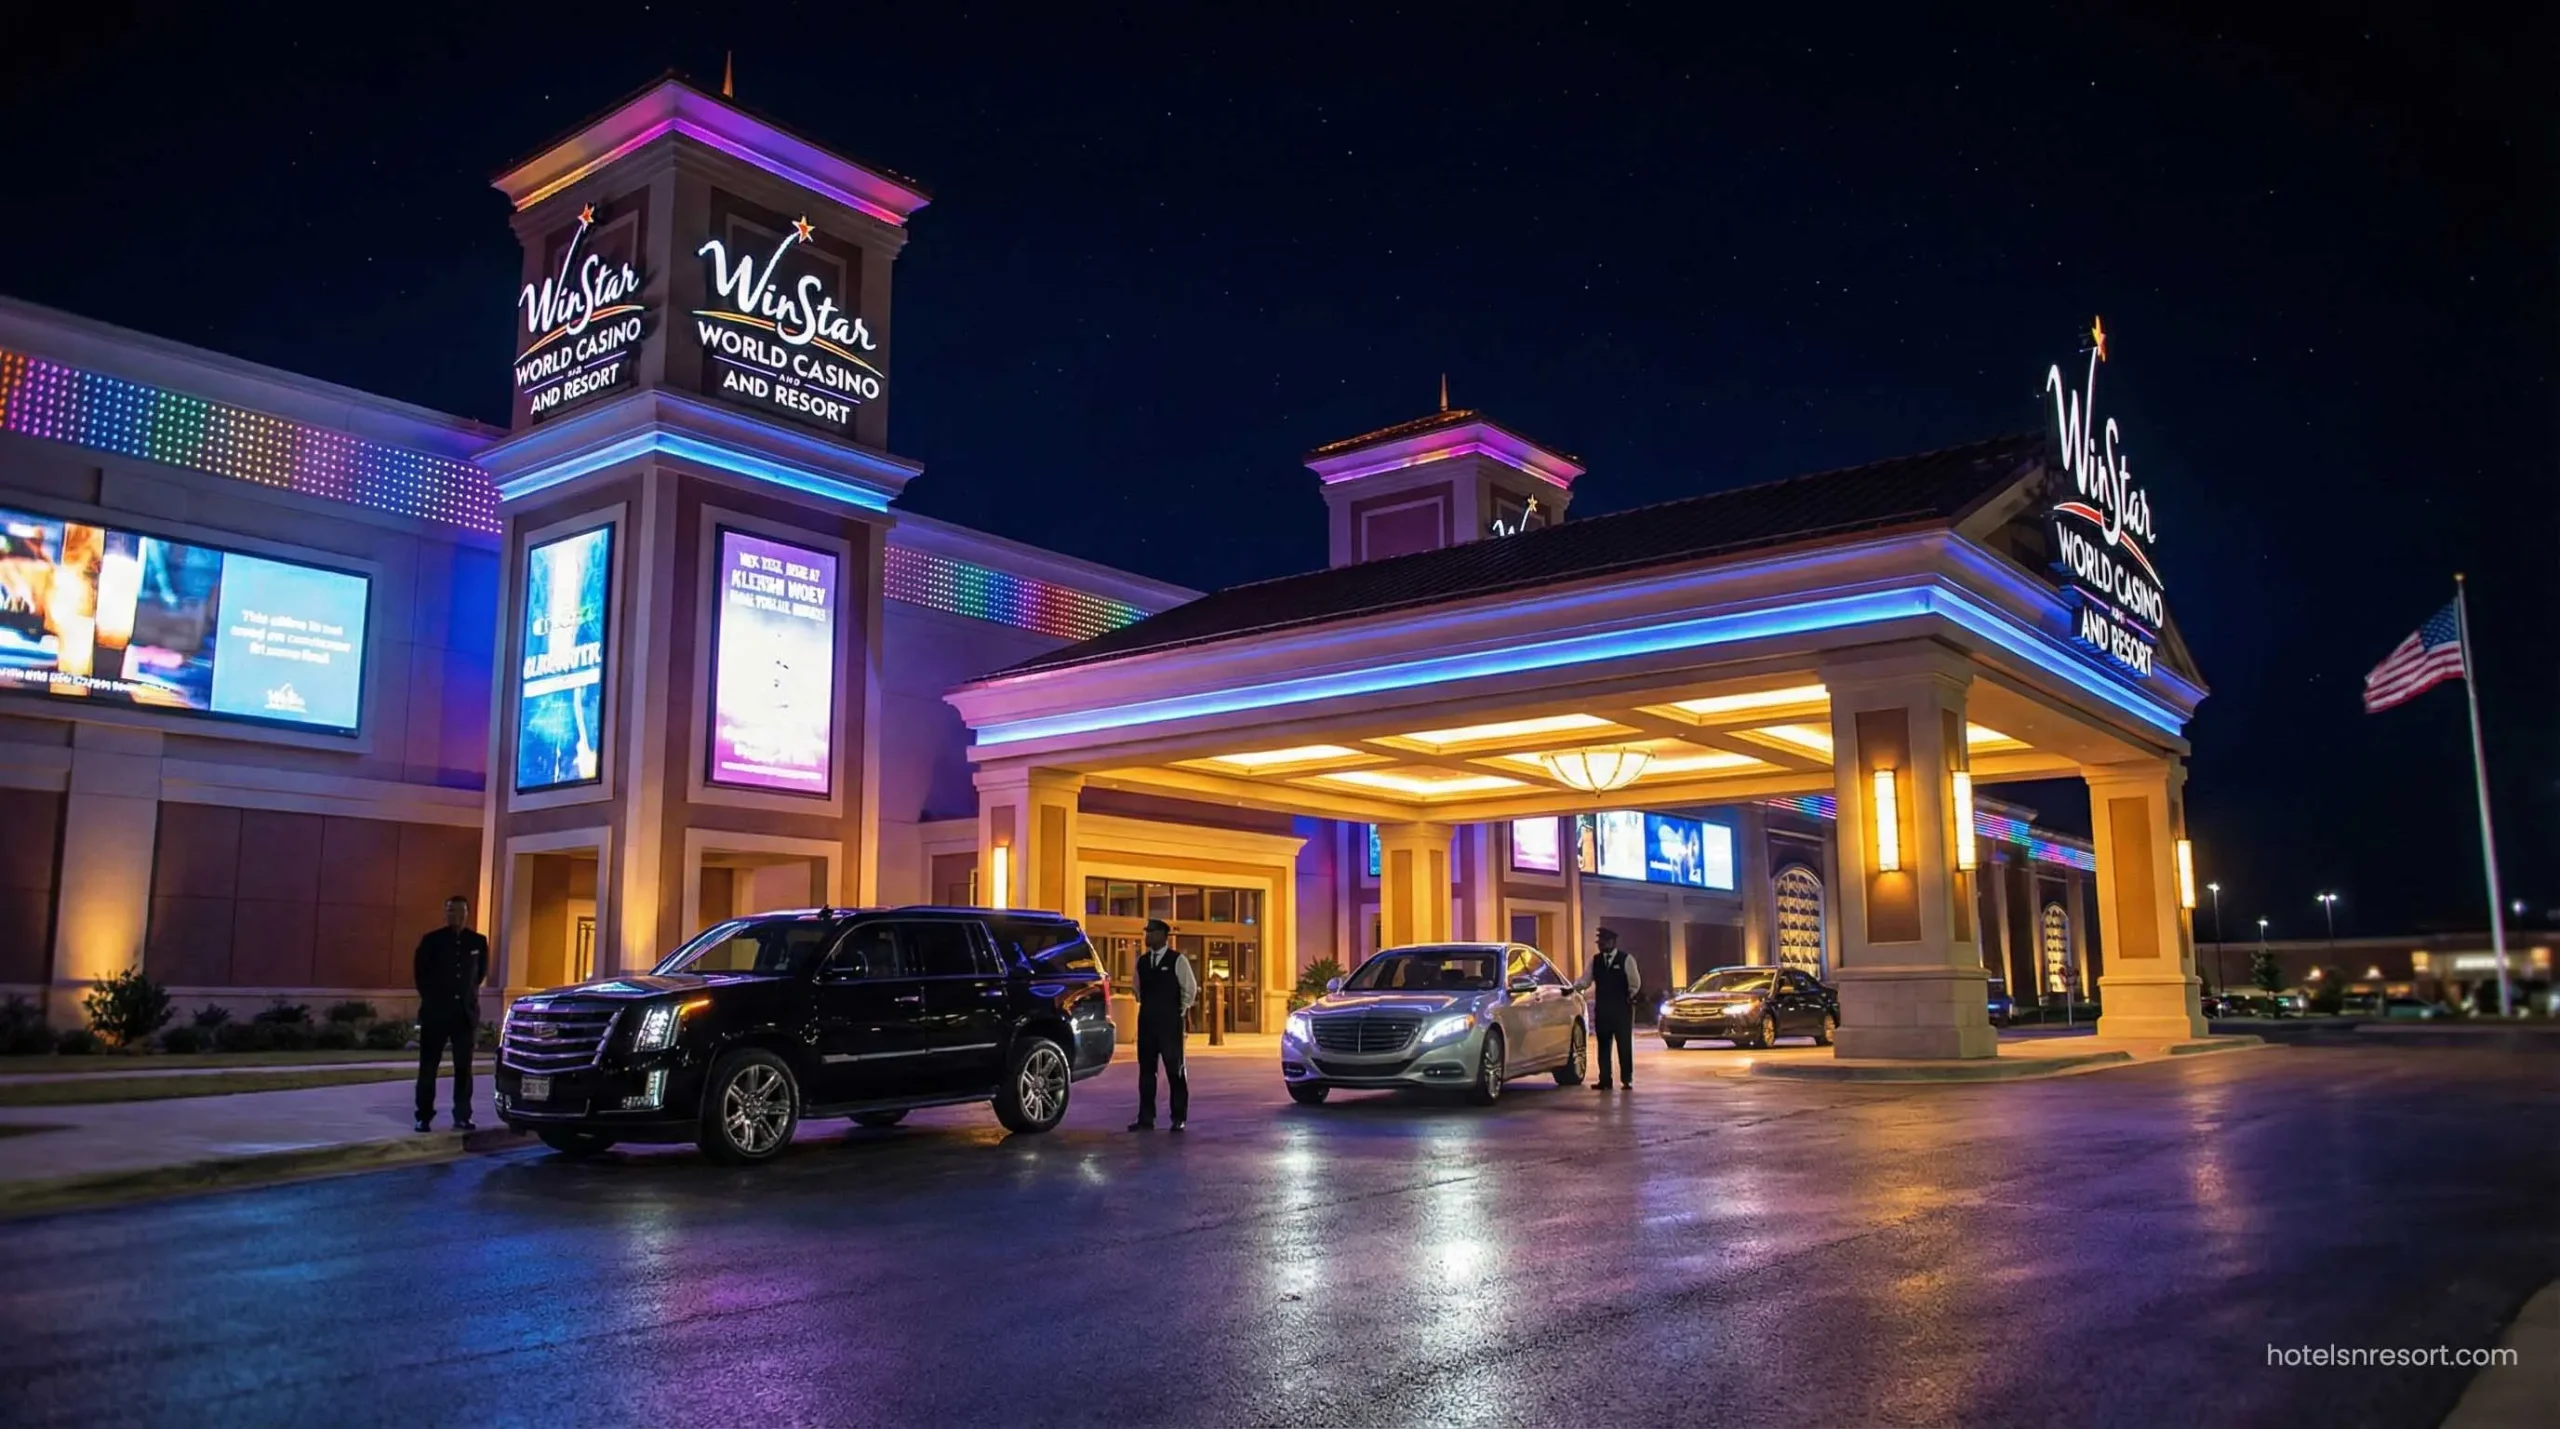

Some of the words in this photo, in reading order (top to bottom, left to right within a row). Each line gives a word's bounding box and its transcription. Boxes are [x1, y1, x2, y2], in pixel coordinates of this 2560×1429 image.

[518, 222, 640, 336] WinStar
[698, 229, 877, 352] WinStar
[515, 346, 573, 387] WORLD
[576, 317, 641, 362] CASINO
[530, 386, 560, 415] AND
[563, 362, 620, 401] RESORT
[697, 320, 788, 369] WORLD
[792, 354, 880, 400] CASINO
[778, 373, 801, 387] AND
[722, 369, 769, 398] AND
[775, 384, 850, 424] RESORT
[2046, 346, 2157, 547] WinStar
[2056, 521, 2113, 593] WORLD
[2114, 564, 2164, 628] CASINO
[2081, 605, 2109, 651] AND
[2110, 624, 2153, 677] RESORT
